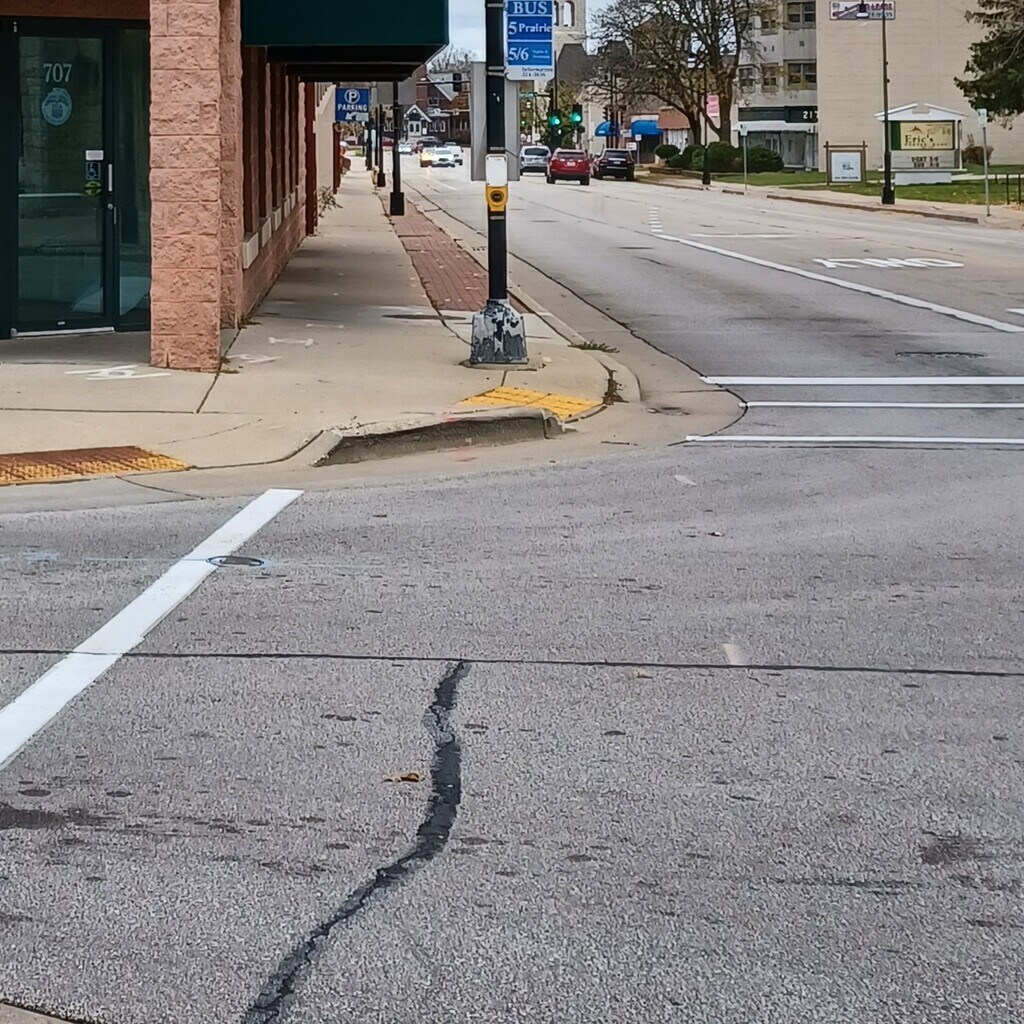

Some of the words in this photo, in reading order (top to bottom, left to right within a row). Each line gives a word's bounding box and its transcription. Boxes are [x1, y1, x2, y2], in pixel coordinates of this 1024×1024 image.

[513, 1, 547, 14] BUS
[508, 21, 517, 35] 5
[518, 22, 552, 33] Prairie
[508, 47, 530, 61] 5/6
[43, 63, 72, 83] 707
[337, 103, 368, 111] PARKING
